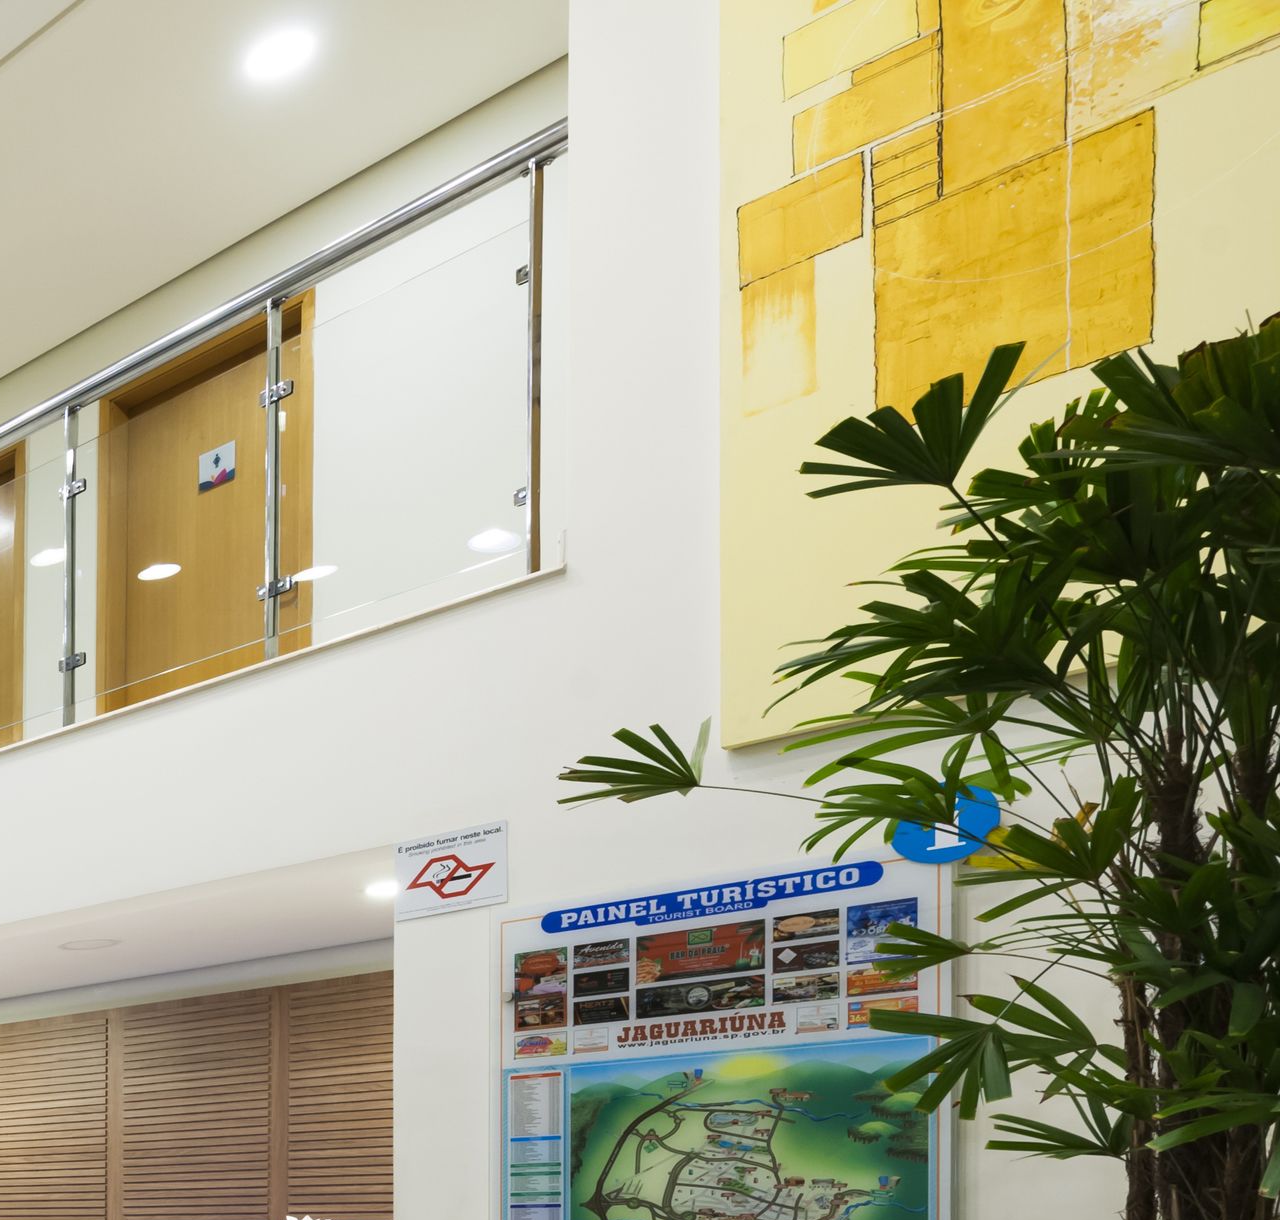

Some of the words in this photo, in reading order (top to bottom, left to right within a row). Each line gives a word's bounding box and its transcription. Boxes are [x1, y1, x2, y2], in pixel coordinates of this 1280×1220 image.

[405, 841, 434, 853] proibido
[436, 836, 458, 845] fumar
[460, 831, 481, 841] neste
[560, 899, 666, 929] PAINEL
[677, 866, 861, 908] TURÍSTICO
[648, 908, 702, 923] TOURIST
[705, 901, 753, 916] BOARD
[616, 1011, 787, 1043] JAGUARIÚNA
[617, 1028, 787, 1049] www.jaguariuna.sp.gov.br
